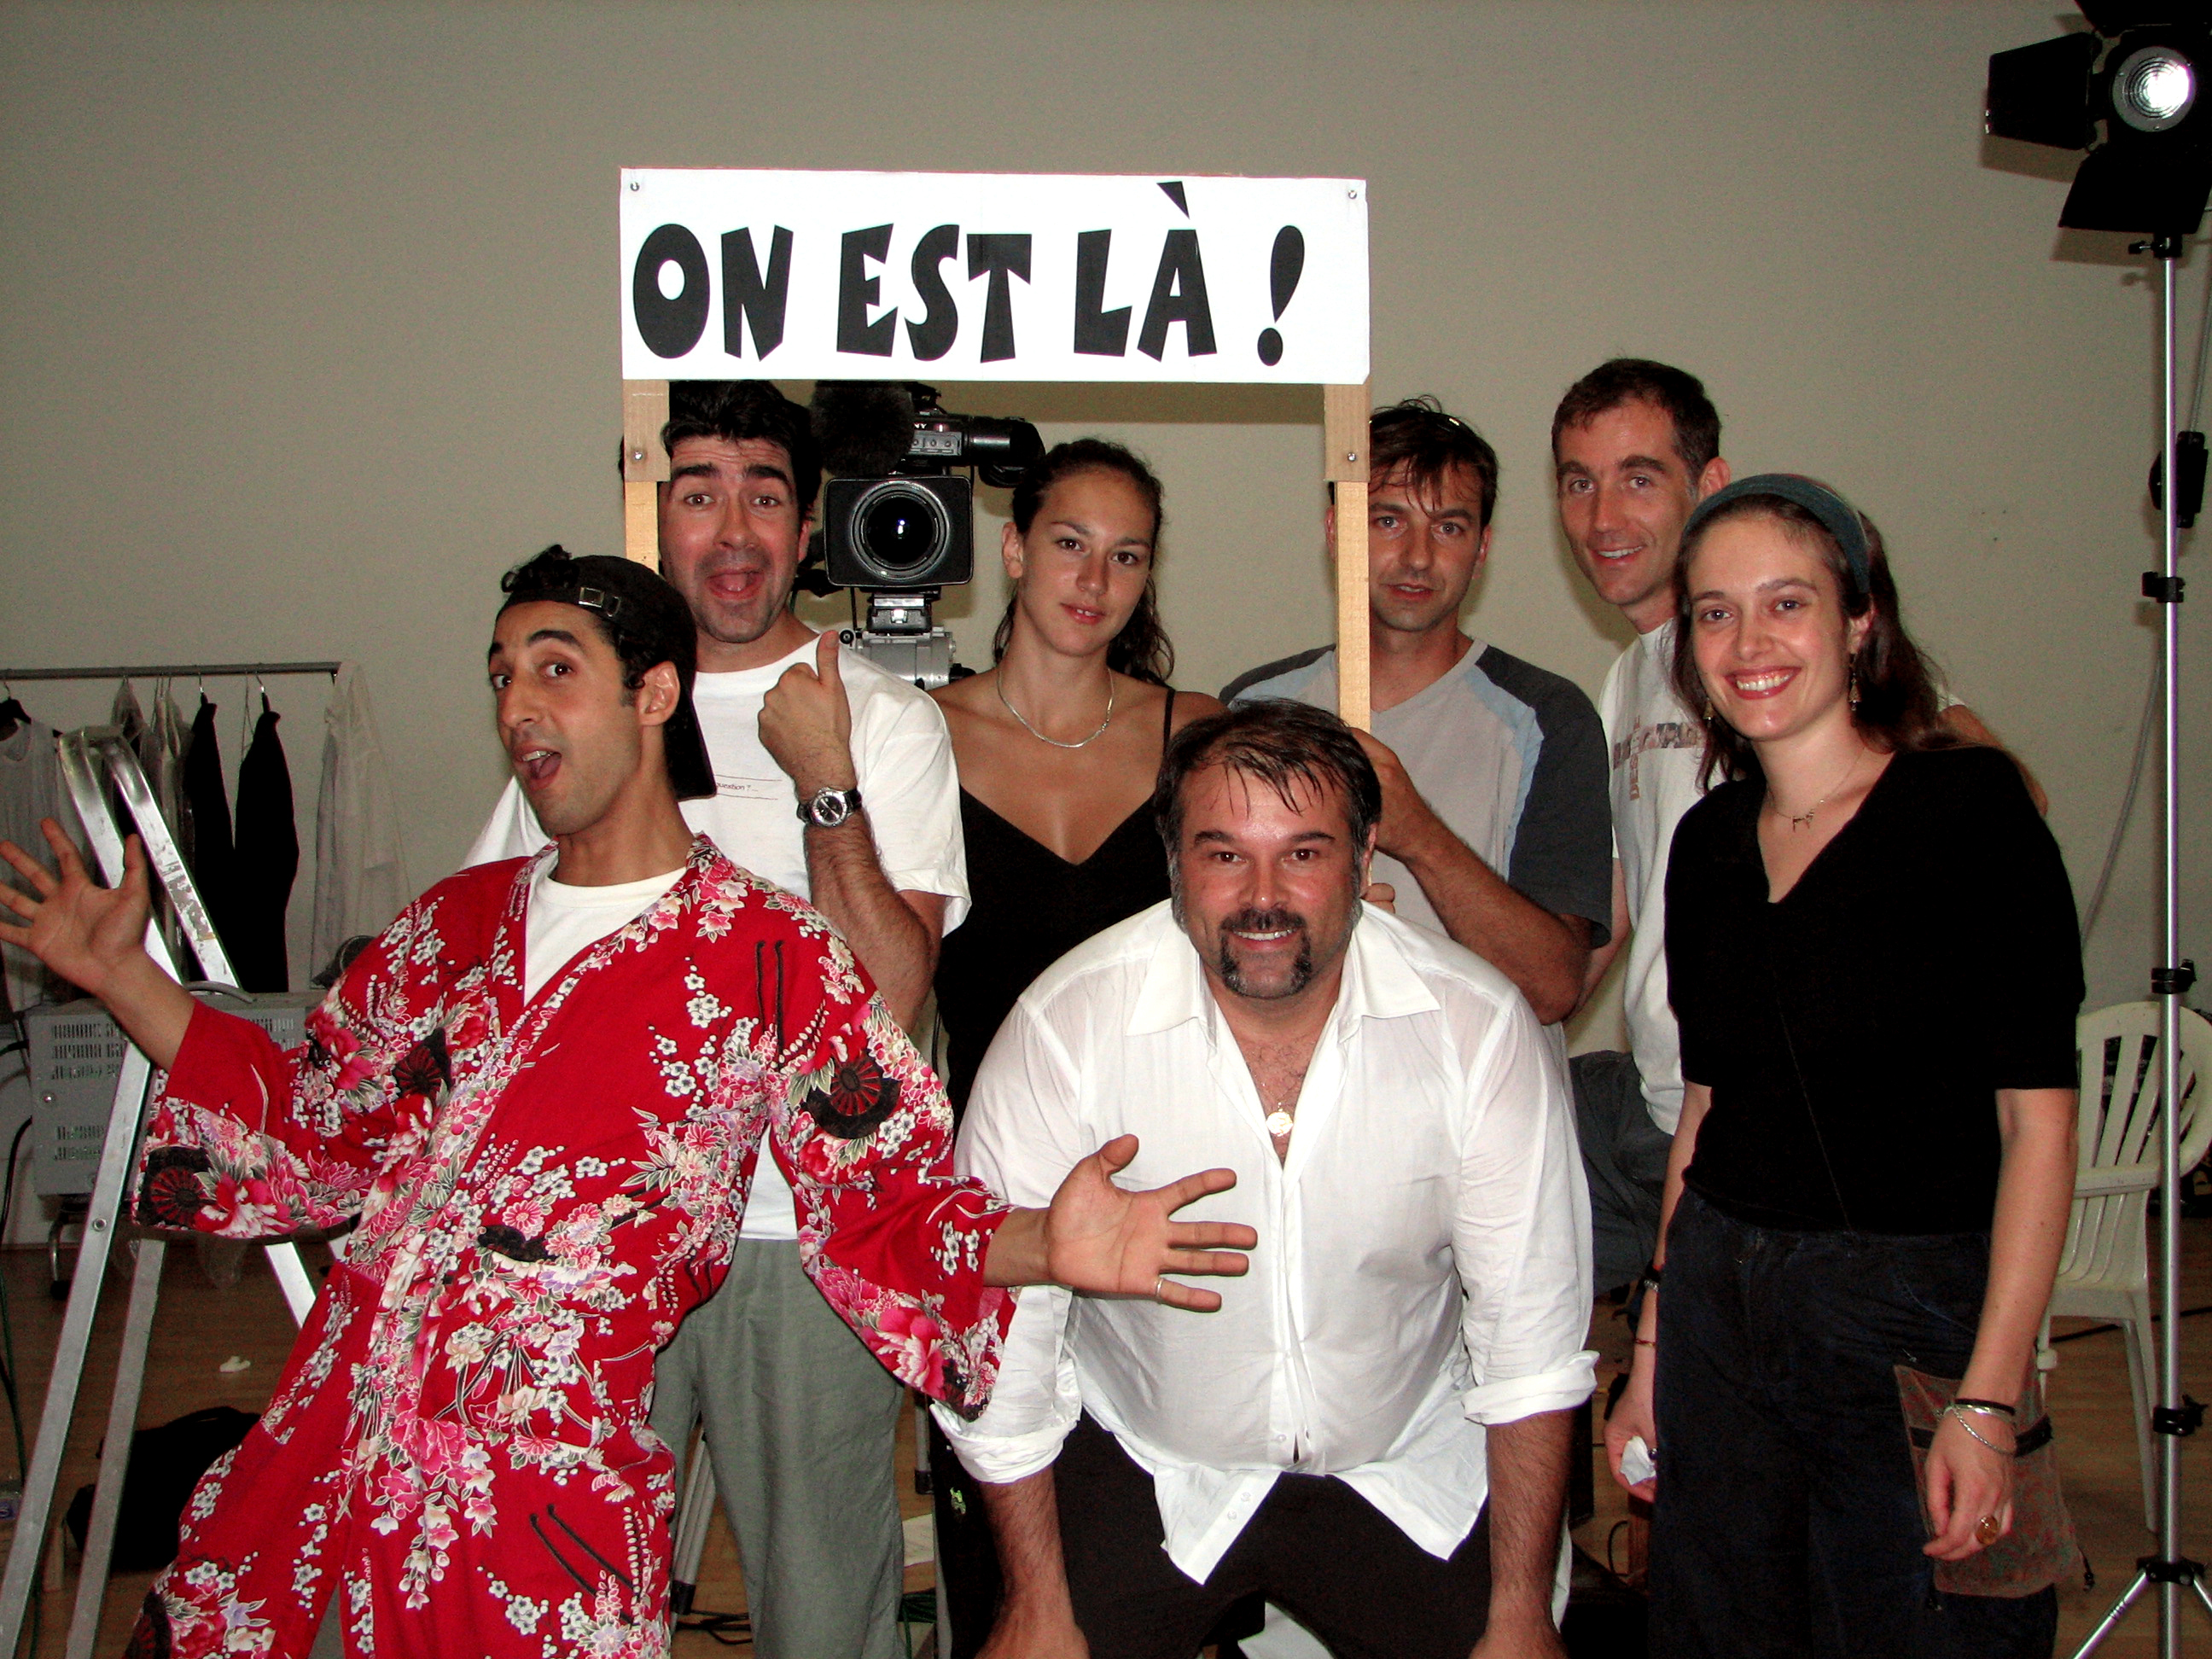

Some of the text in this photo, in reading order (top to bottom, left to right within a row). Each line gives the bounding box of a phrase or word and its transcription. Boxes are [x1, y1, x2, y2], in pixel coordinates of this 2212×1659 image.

[633, 181, 1305, 366] ON EST LÀ !
